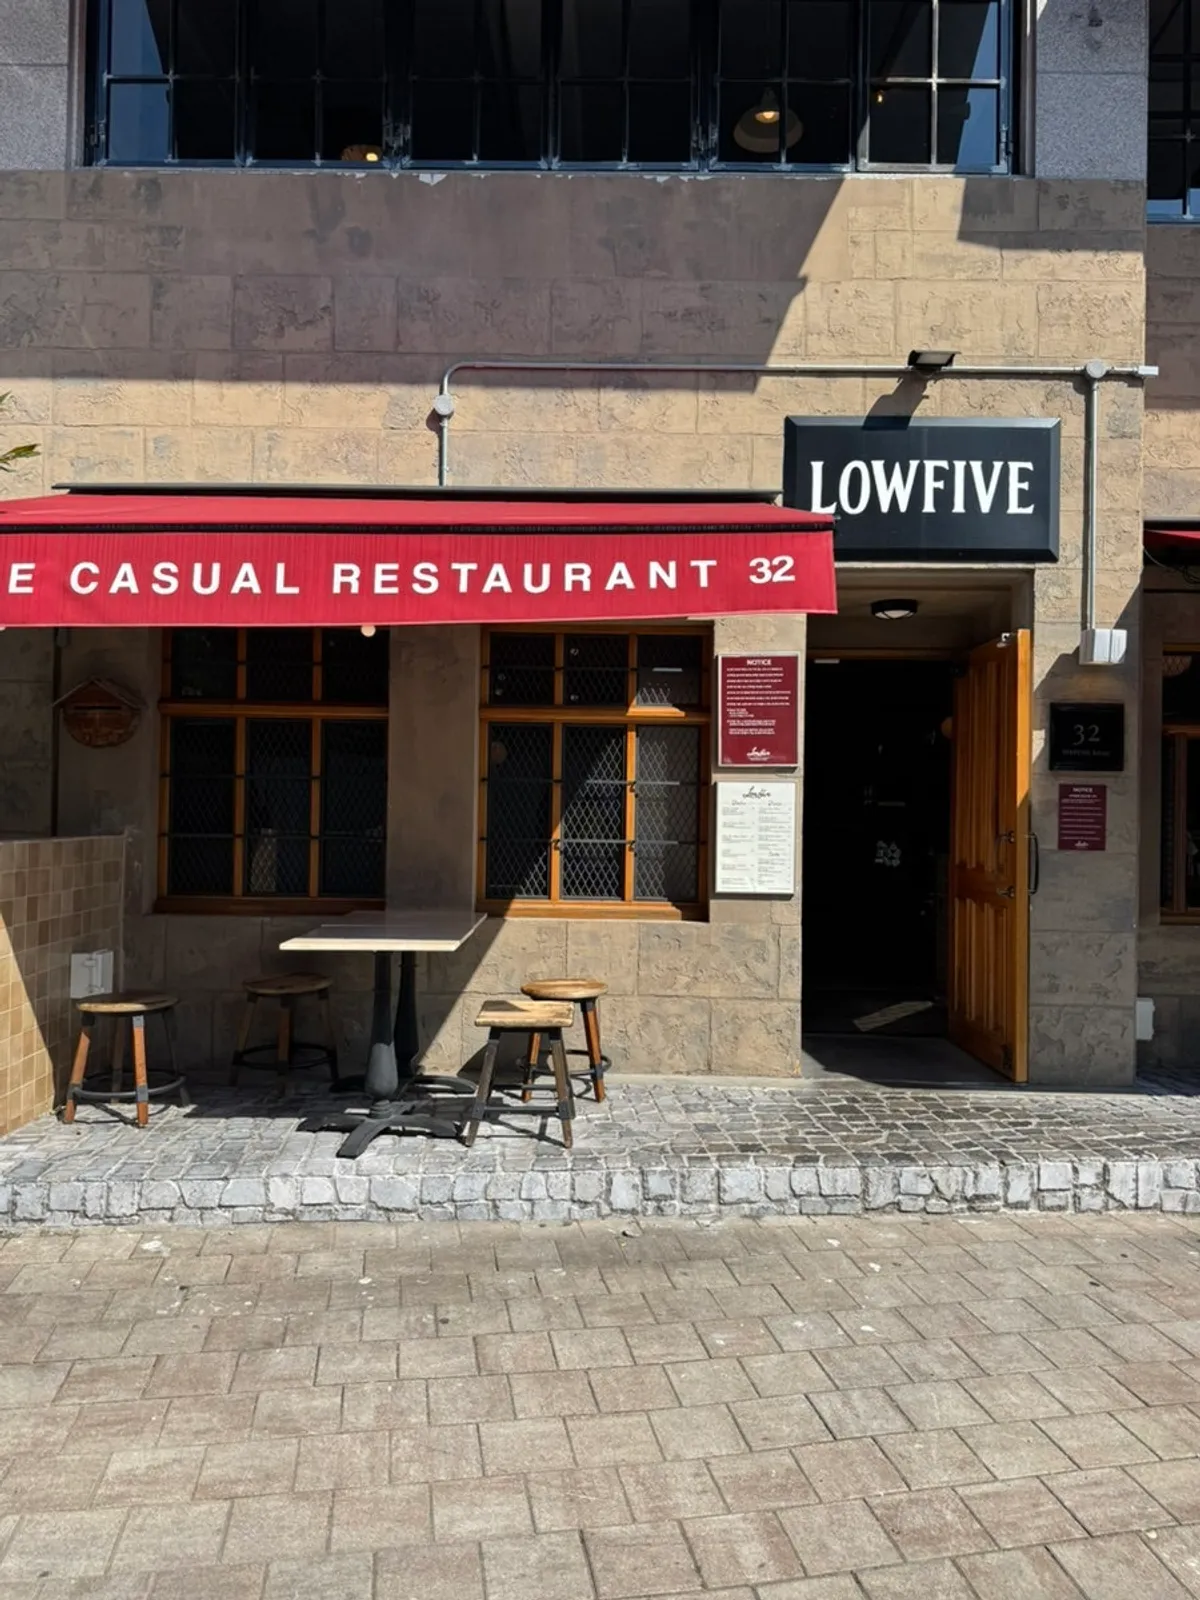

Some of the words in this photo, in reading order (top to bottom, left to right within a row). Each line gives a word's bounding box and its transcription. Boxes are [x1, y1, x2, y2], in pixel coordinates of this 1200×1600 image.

[810, 459, 1036, 516] LOWFIVE
[69, 561, 301, 595] CASUAL
[332, 559, 718, 595] RESTAURANT
[749, 555, 796, 585] 32
[746, 658, 772, 666] NOTICE
[1073, 724, 1100, 746] 32
